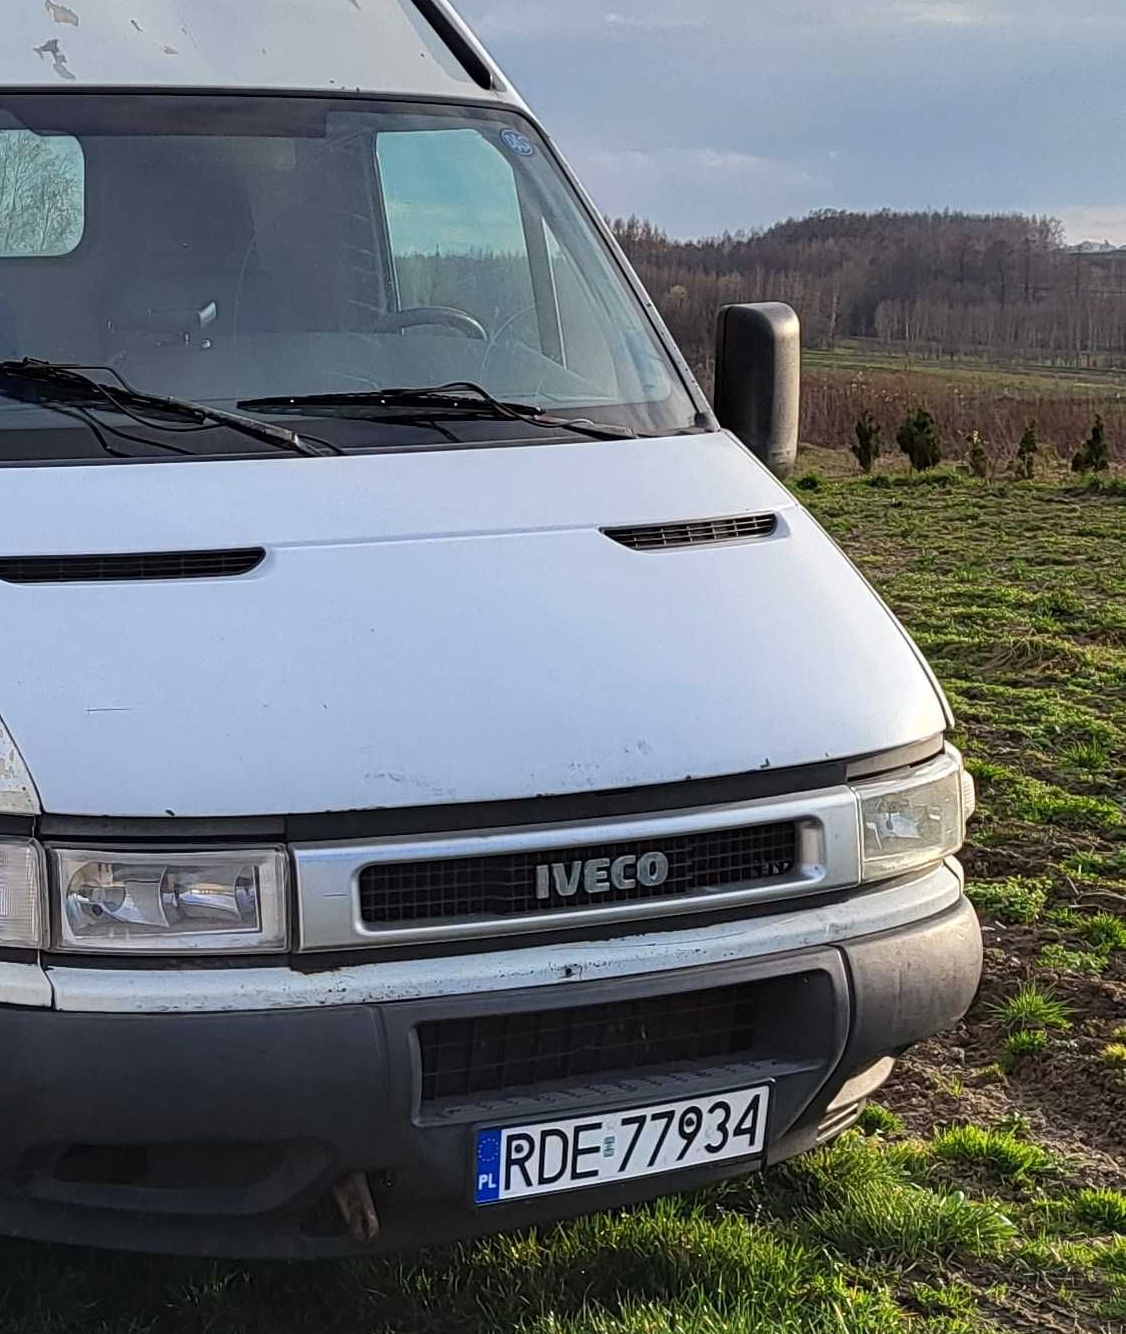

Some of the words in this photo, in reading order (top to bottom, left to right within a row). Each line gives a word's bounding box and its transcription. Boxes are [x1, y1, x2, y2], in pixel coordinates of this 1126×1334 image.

[536, 851, 669, 899] IVECO
[504, 1121, 603, 1191] RDE
[617, 1093, 762, 1173] 77934
[478, 1174, 497, 1191] PL
